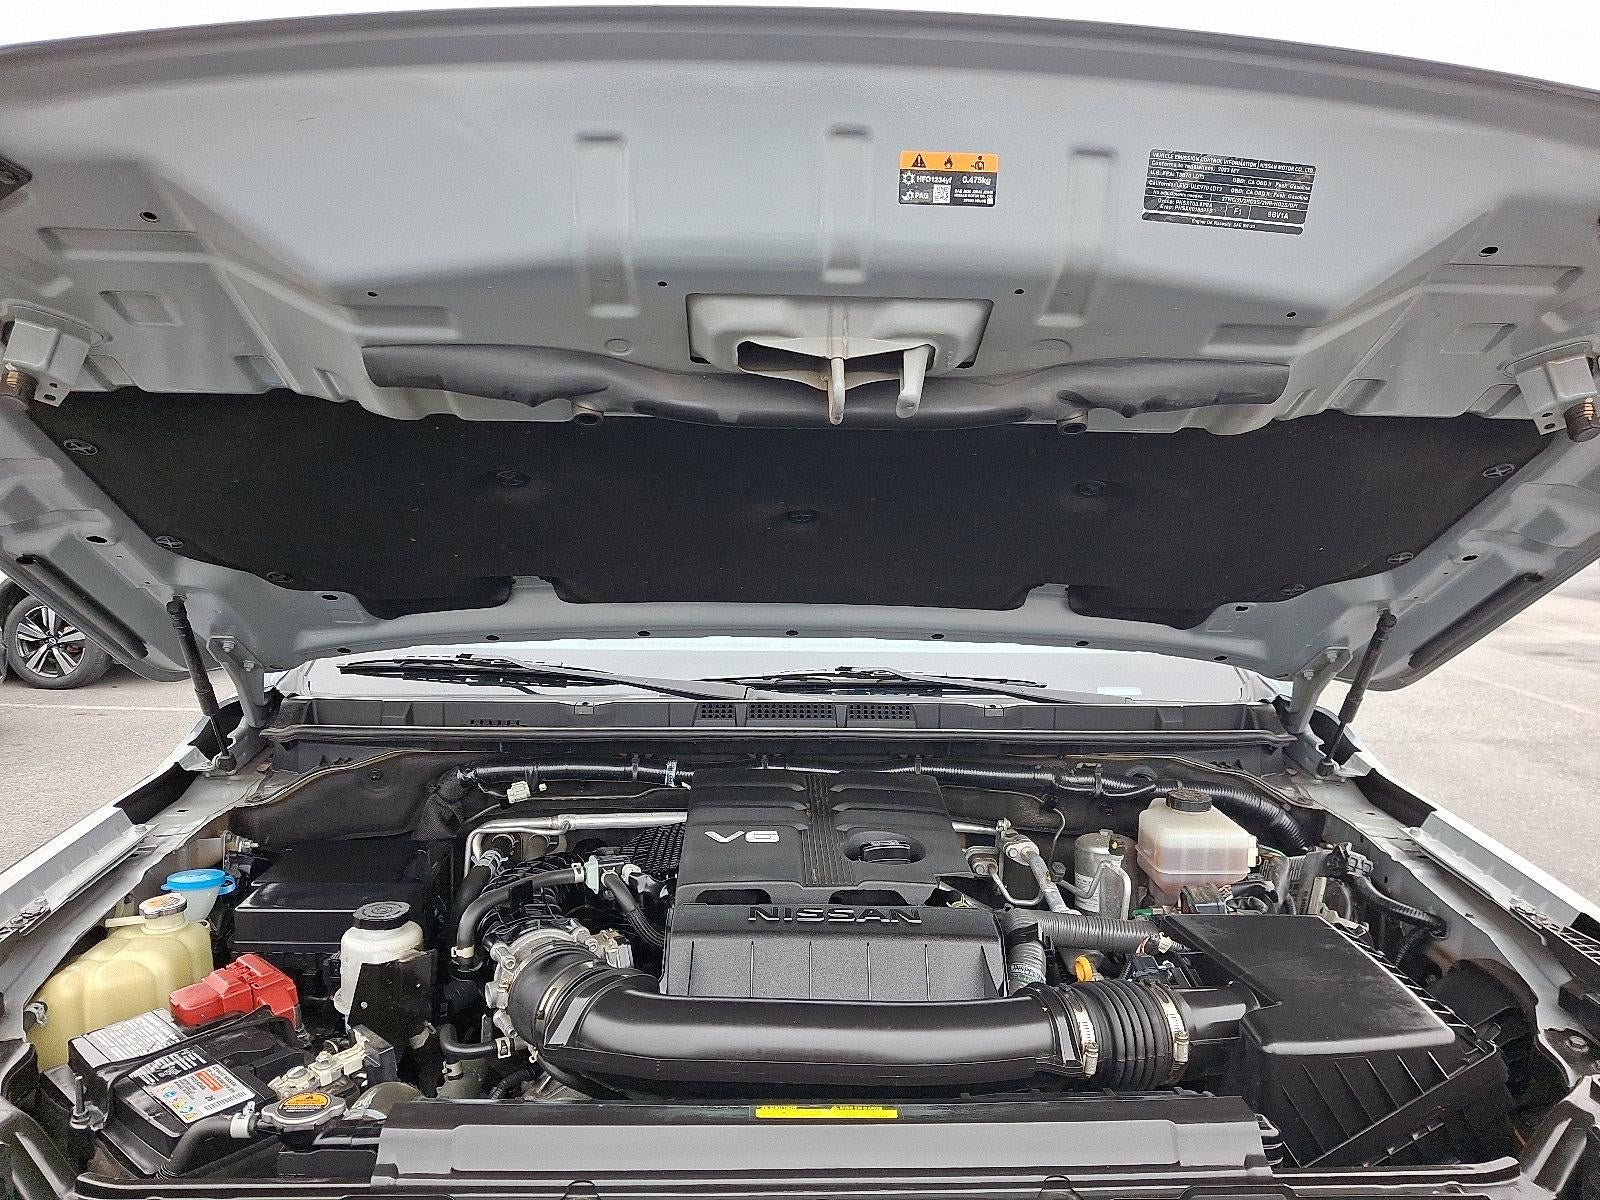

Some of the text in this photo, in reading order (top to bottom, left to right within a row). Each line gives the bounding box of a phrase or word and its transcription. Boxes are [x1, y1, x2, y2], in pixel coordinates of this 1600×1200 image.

[916, 175, 952, 184] HFO1234yf
[962, 176, 991, 185] 0.475kg
[704, 830, 780, 843] V6
[748, 907, 922, 924] NISSAN
